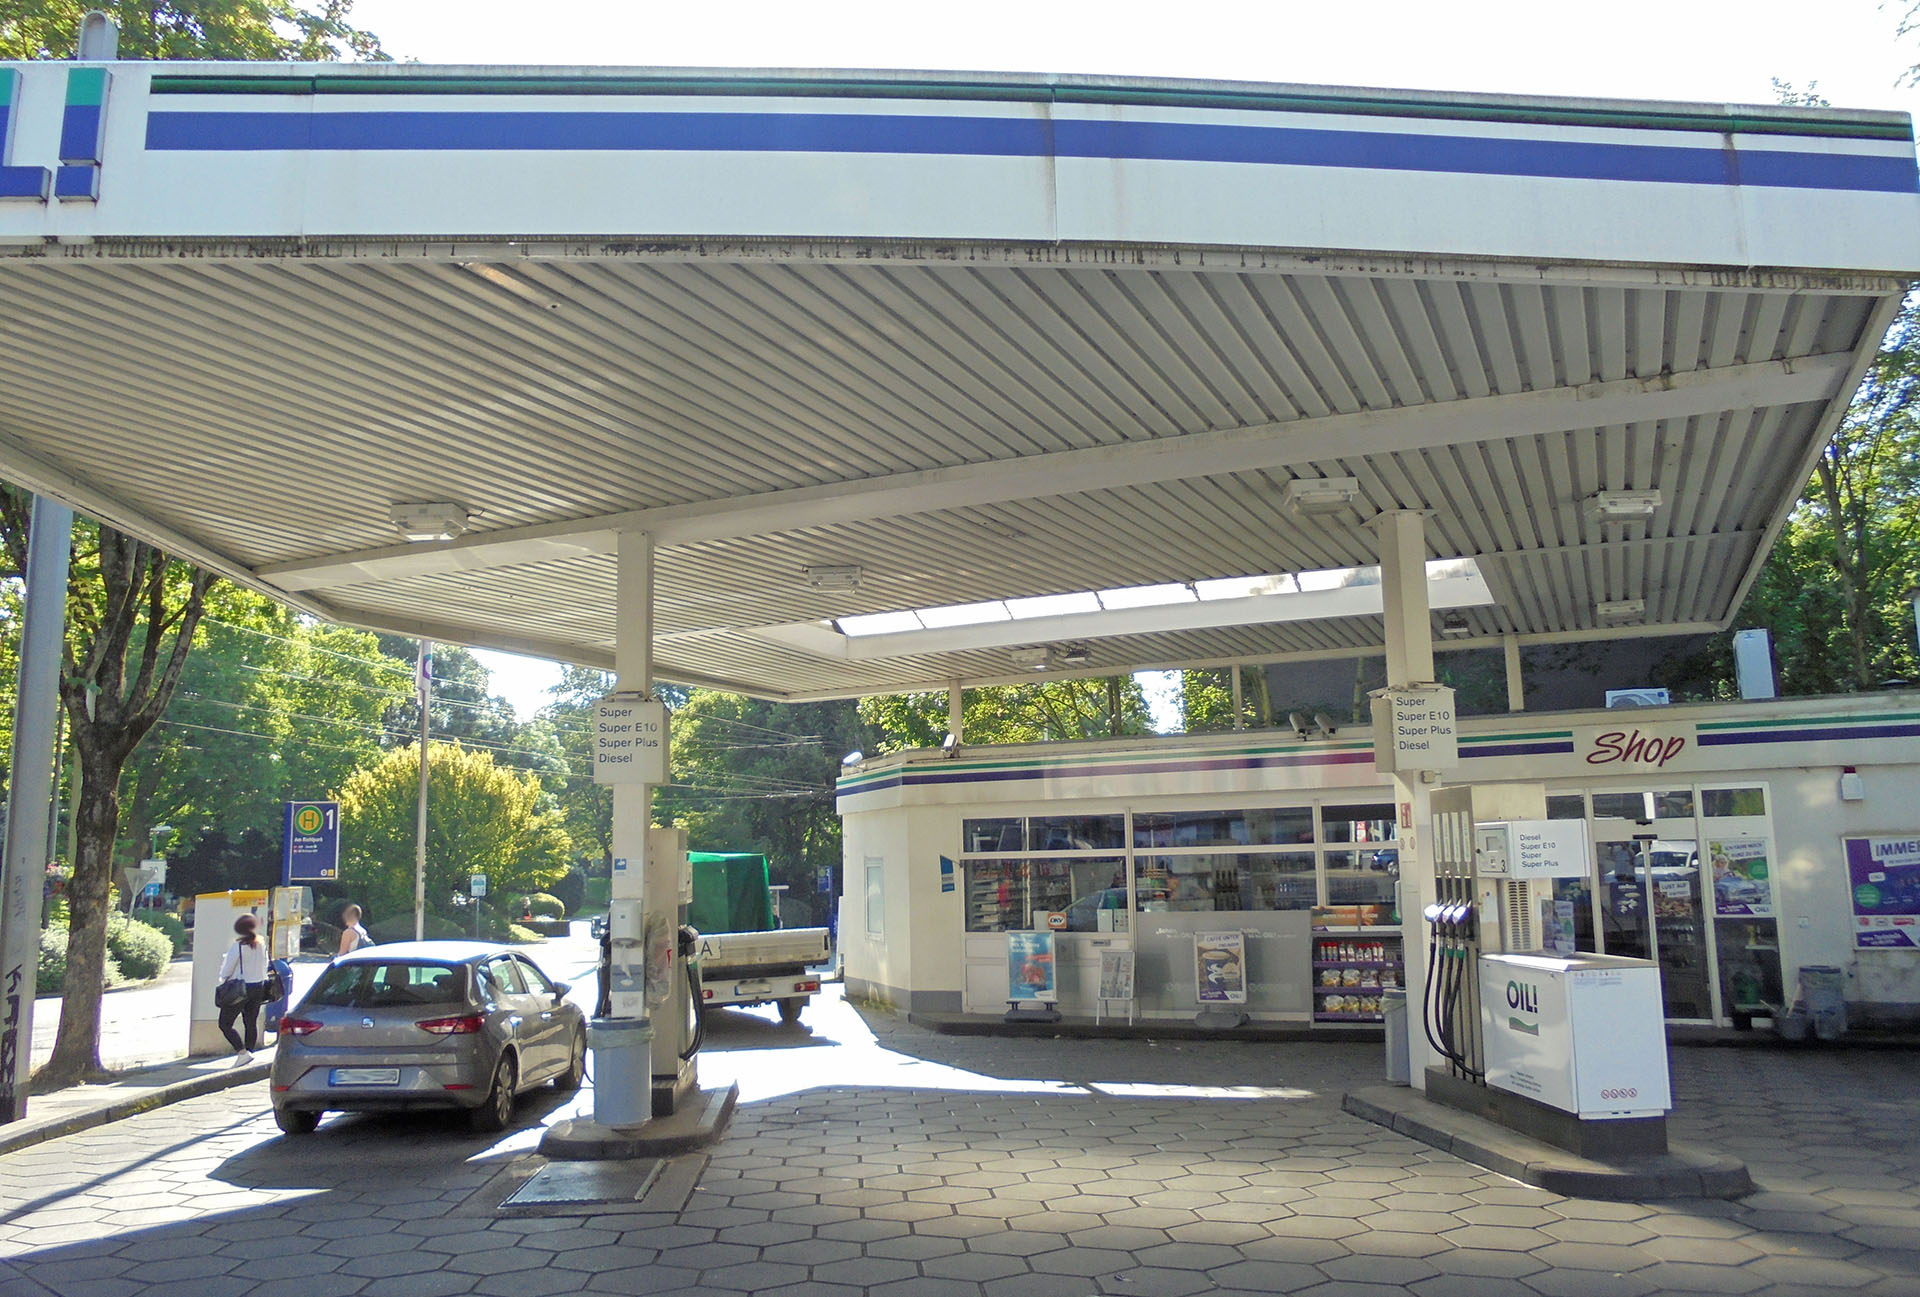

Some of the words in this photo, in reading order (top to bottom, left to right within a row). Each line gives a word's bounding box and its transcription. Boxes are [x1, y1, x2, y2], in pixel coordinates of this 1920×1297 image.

[1396, 697, 1426, 707] Super
[600, 707, 633, 718] Super
[1397, 711, 1426, 722] Super
[1429, 711, 1450, 720] E10
[599, 722, 632, 733] Super
[1398, 725, 1428, 736] Super
[1430, 726, 1452, 735] Plus
[599, 737, 632, 749] Super
[635, 737, 659, 748] Plus
[1399, 740, 1430, 750] Diesel
[1586, 729, 1686, 768] Shop
[599, 753, 633, 763] Diesel
[325, 809, 334, 830] 1
[1520, 843, 1541, 851] Super
[1876, 841, 1920, 857] IMME
[1521, 852, 1541, 860] Super
[1522, 861, 1542, 869] Super
[700, 940, 713, 956] A
[1506, 979, 1538, 1014] OIL!
